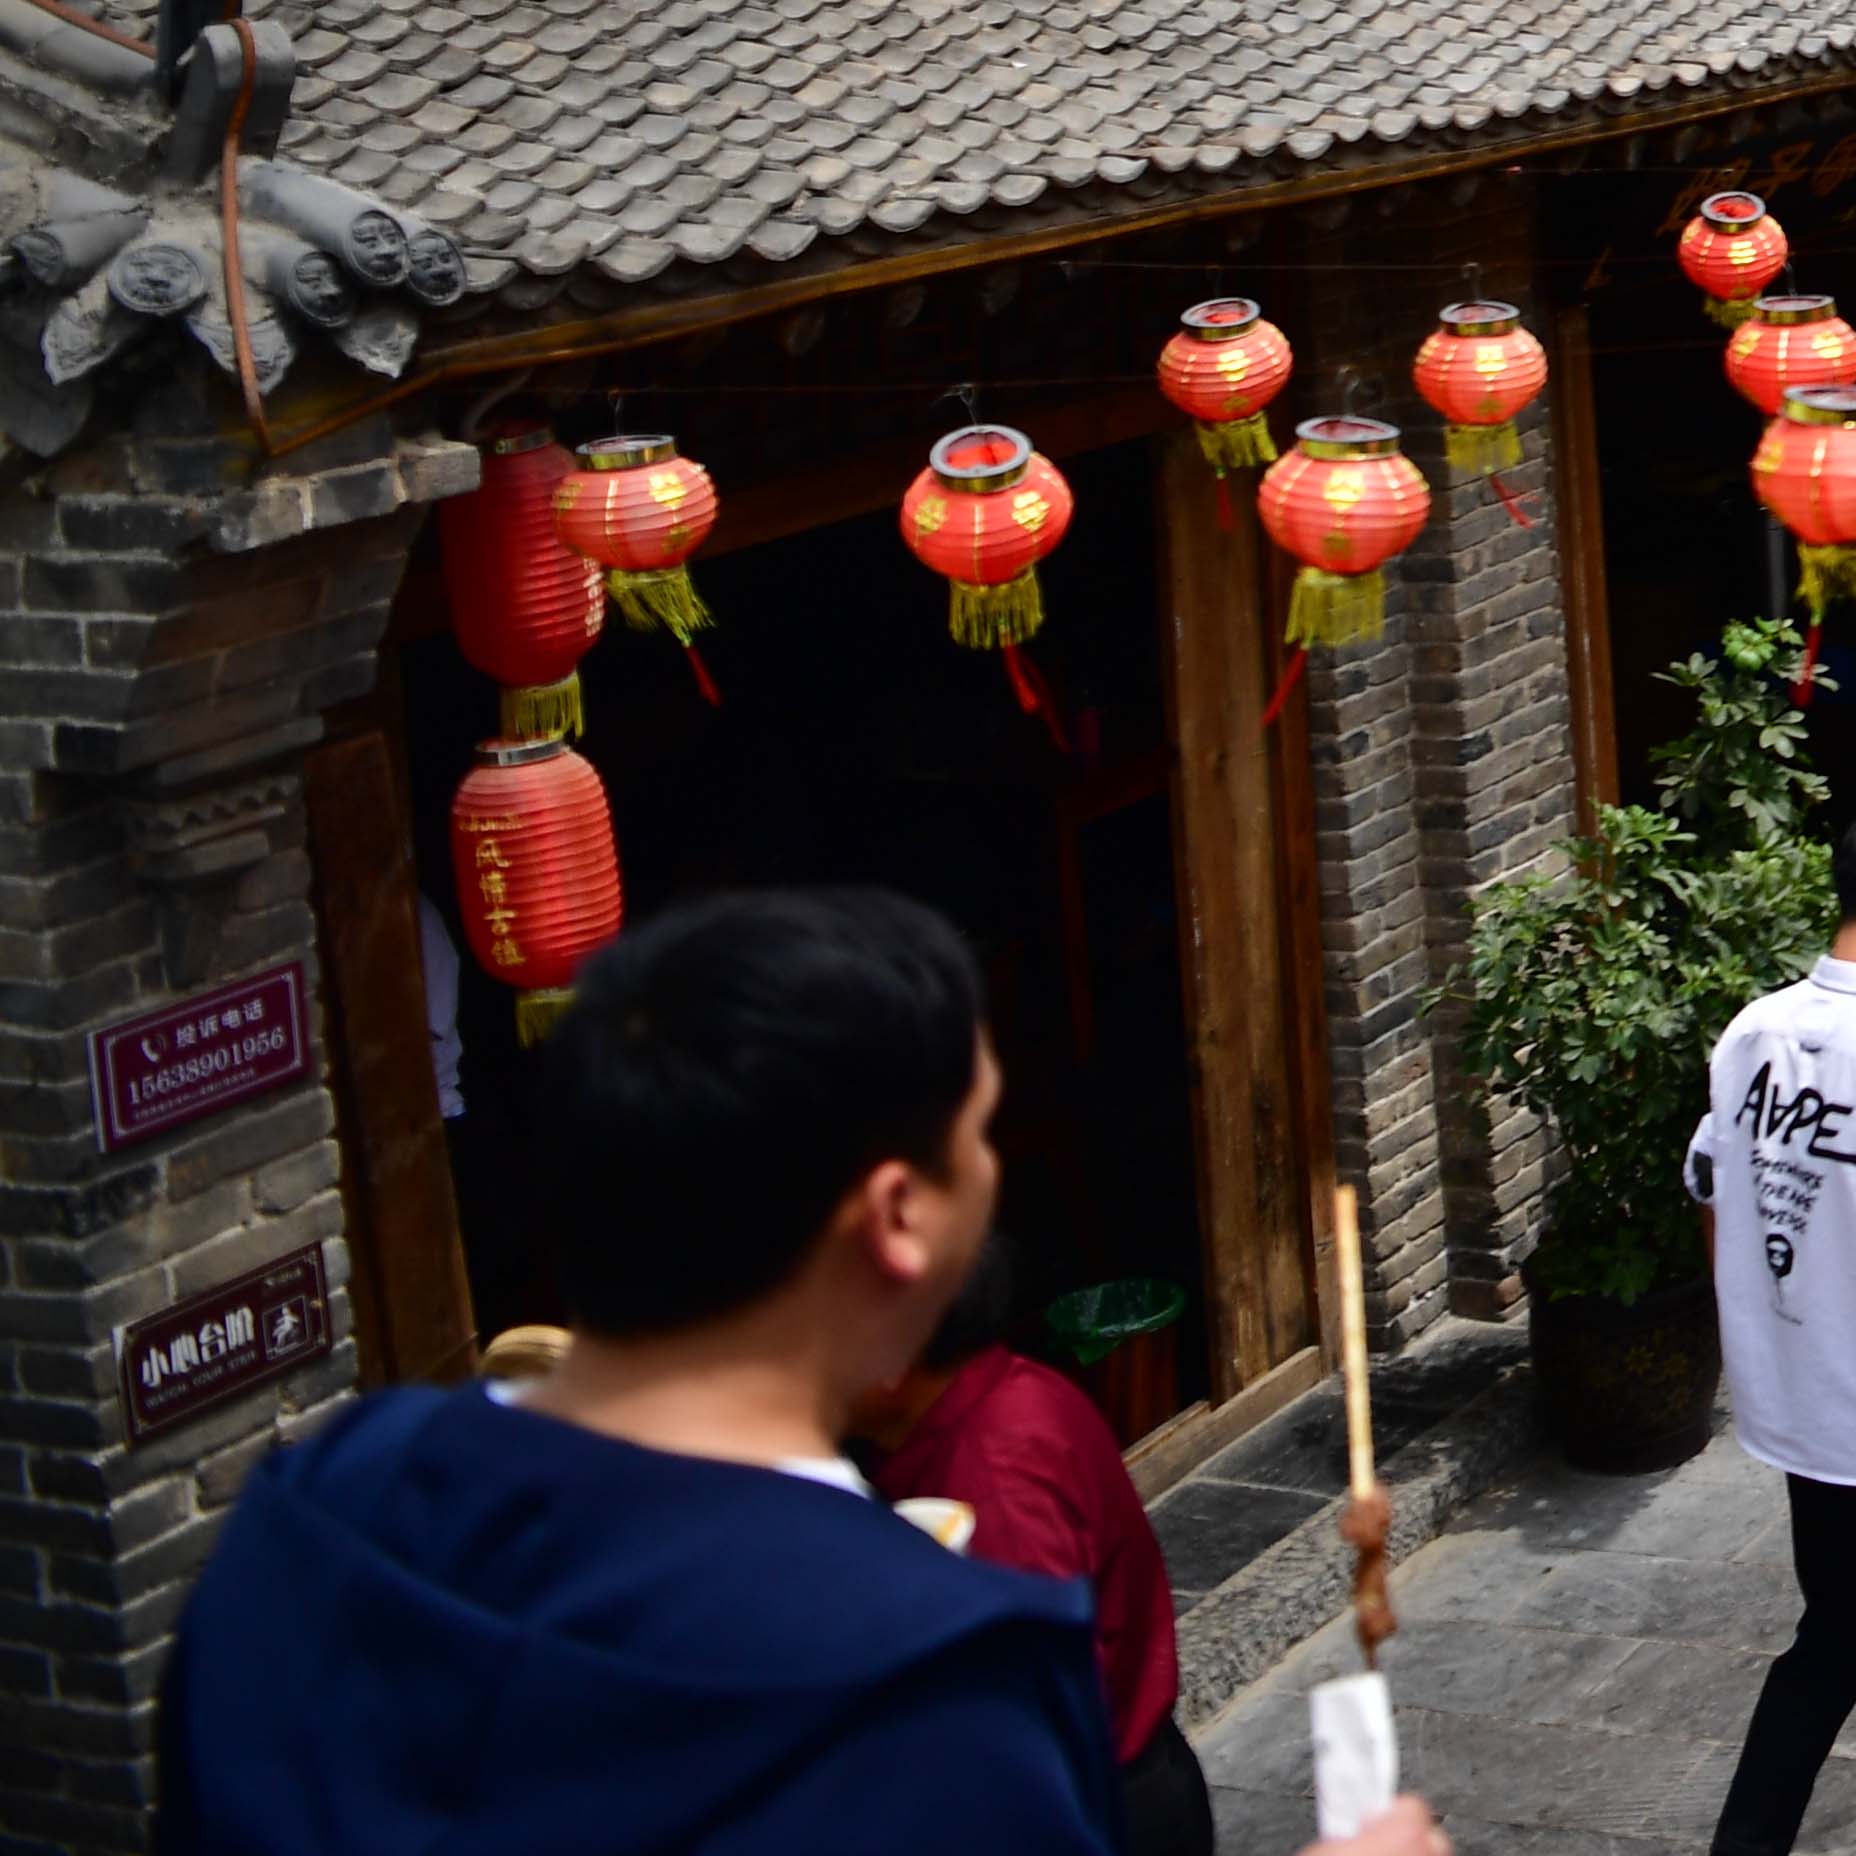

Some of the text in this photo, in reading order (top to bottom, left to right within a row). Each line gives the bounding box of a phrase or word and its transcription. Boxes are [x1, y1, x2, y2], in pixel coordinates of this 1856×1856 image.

[474, 837, 527, 967] 风情古镇
[175, 998, 264, 1049] 投诉电话
[129, 1025, 286, 1105] 15638901956
[141, 1305, 256, 1388] 小心台阶
